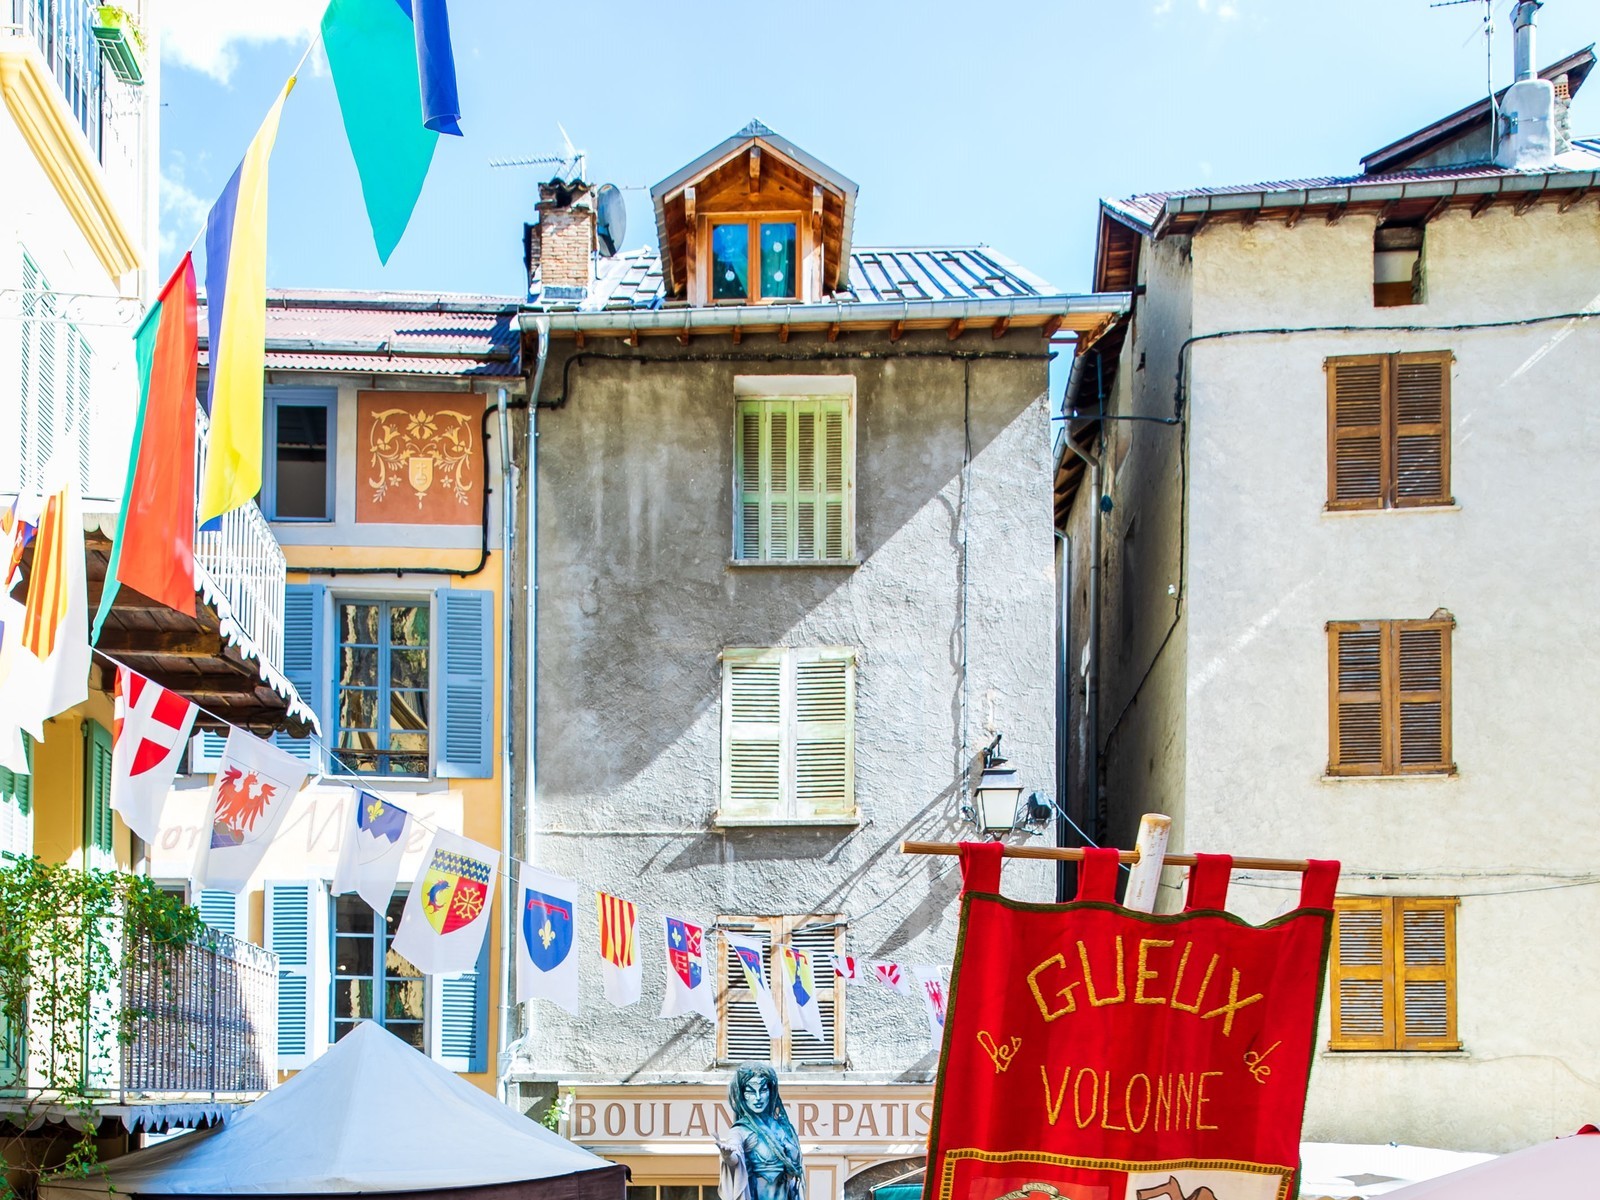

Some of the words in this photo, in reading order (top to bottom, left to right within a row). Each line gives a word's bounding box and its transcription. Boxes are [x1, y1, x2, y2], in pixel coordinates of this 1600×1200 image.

[1026, 935, 1264, 1038] GUEUX
[1243, 1040, 1282, 1084] de
[1040, 1064, 1224, 1133] VOLONNE
